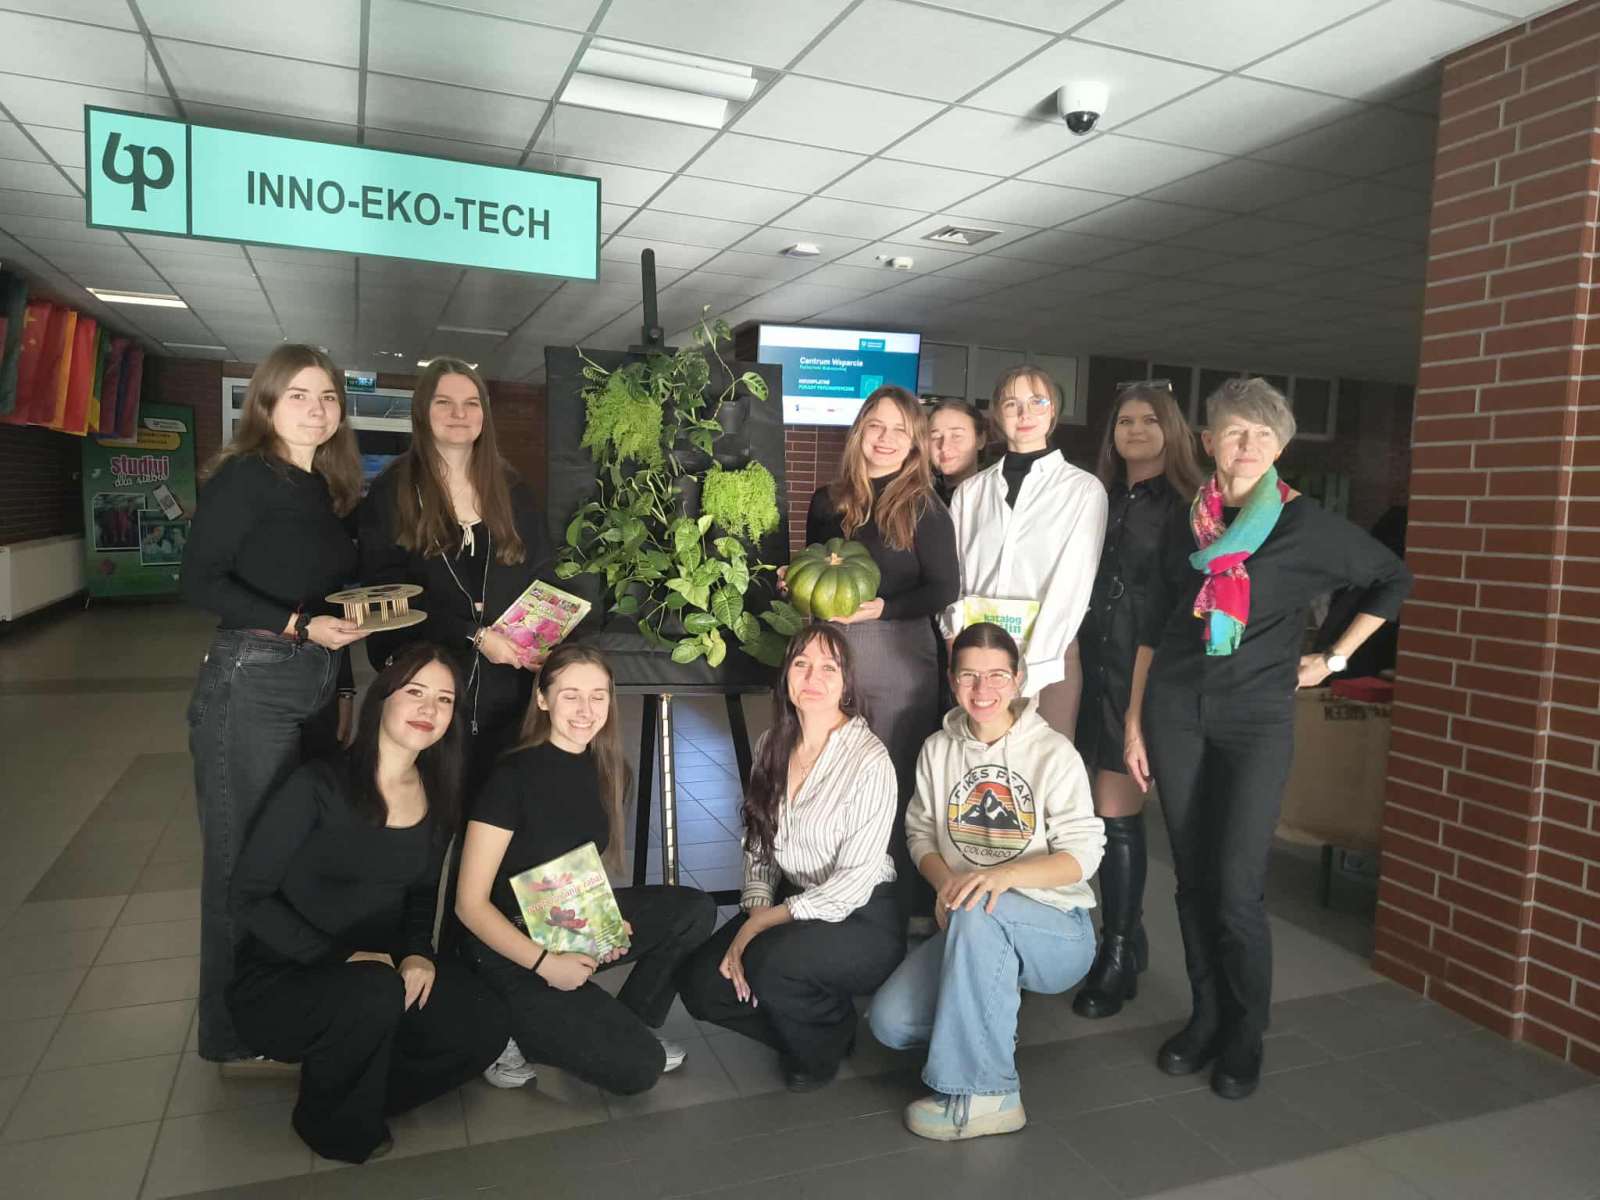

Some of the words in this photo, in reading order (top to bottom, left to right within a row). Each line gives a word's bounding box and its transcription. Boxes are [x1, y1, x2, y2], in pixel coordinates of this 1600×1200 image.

[247, 170, 551, 241] INNO-EKO-TECH
[800, 356, 830, 366] Centrum
[984, 614, 1022, 624] katalog
[963, 845, 1012, 858] COLORADO
